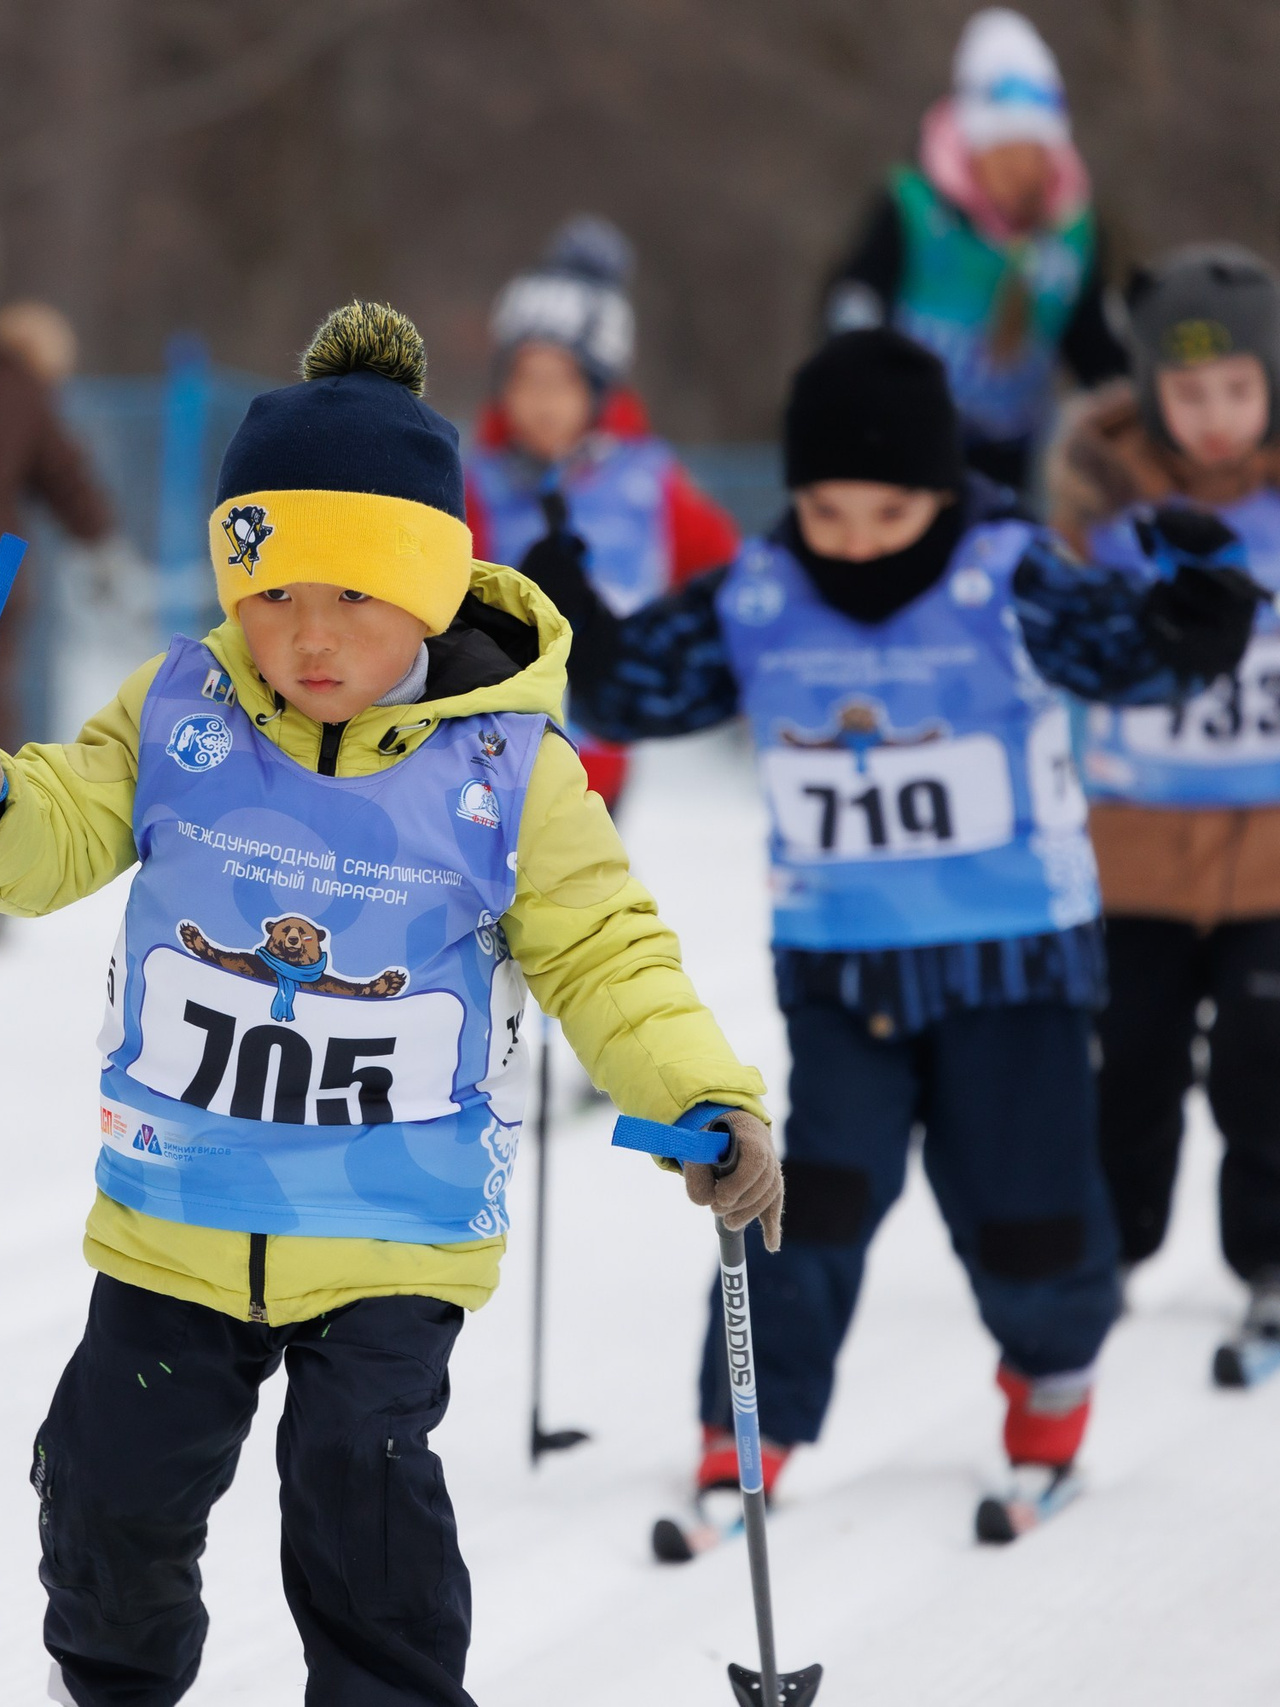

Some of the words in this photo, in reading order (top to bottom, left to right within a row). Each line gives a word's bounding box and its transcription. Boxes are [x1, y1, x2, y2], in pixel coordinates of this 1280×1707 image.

[802, 778, 953, 850] 719
[177, 820, 337, 872] МЕЖДУНАРОДНЫЙ
[221, 859, 306, 891] ЛЫЖНЫЙ
[311, 876, 408, 906] МАРАФОН
[179, 998, 398, 1127] 705
[163, 1141, 197, 1155] ЗИМНИХ
[197, 1146, 232, 1156] ВИДОВ
[163, 1150, 194, 1163] СПОРТА
[723, 1270, 752, 1388] BRADOS
